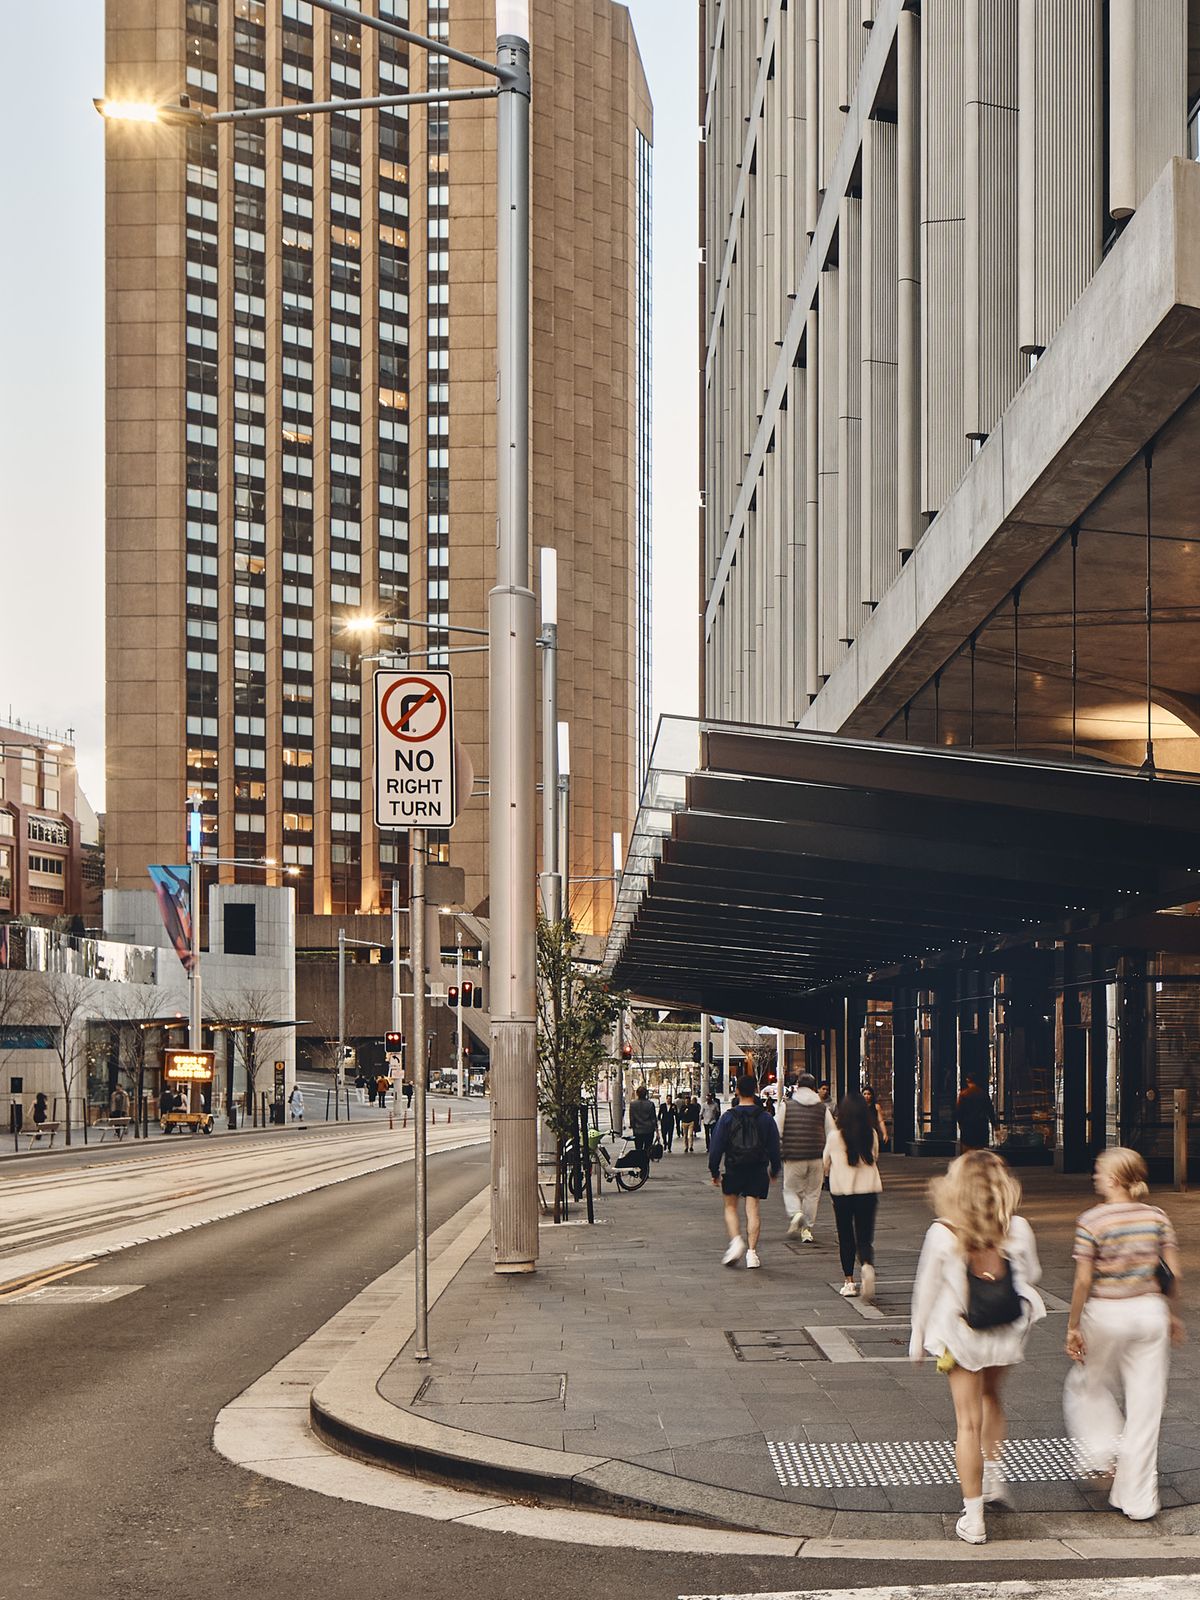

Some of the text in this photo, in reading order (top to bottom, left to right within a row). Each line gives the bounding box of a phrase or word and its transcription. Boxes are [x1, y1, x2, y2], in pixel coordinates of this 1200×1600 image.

[395, 749, 435, 773] NO
[386, 778, 443, 795] RIGHT
[389, 800, 441, 817] TURN
